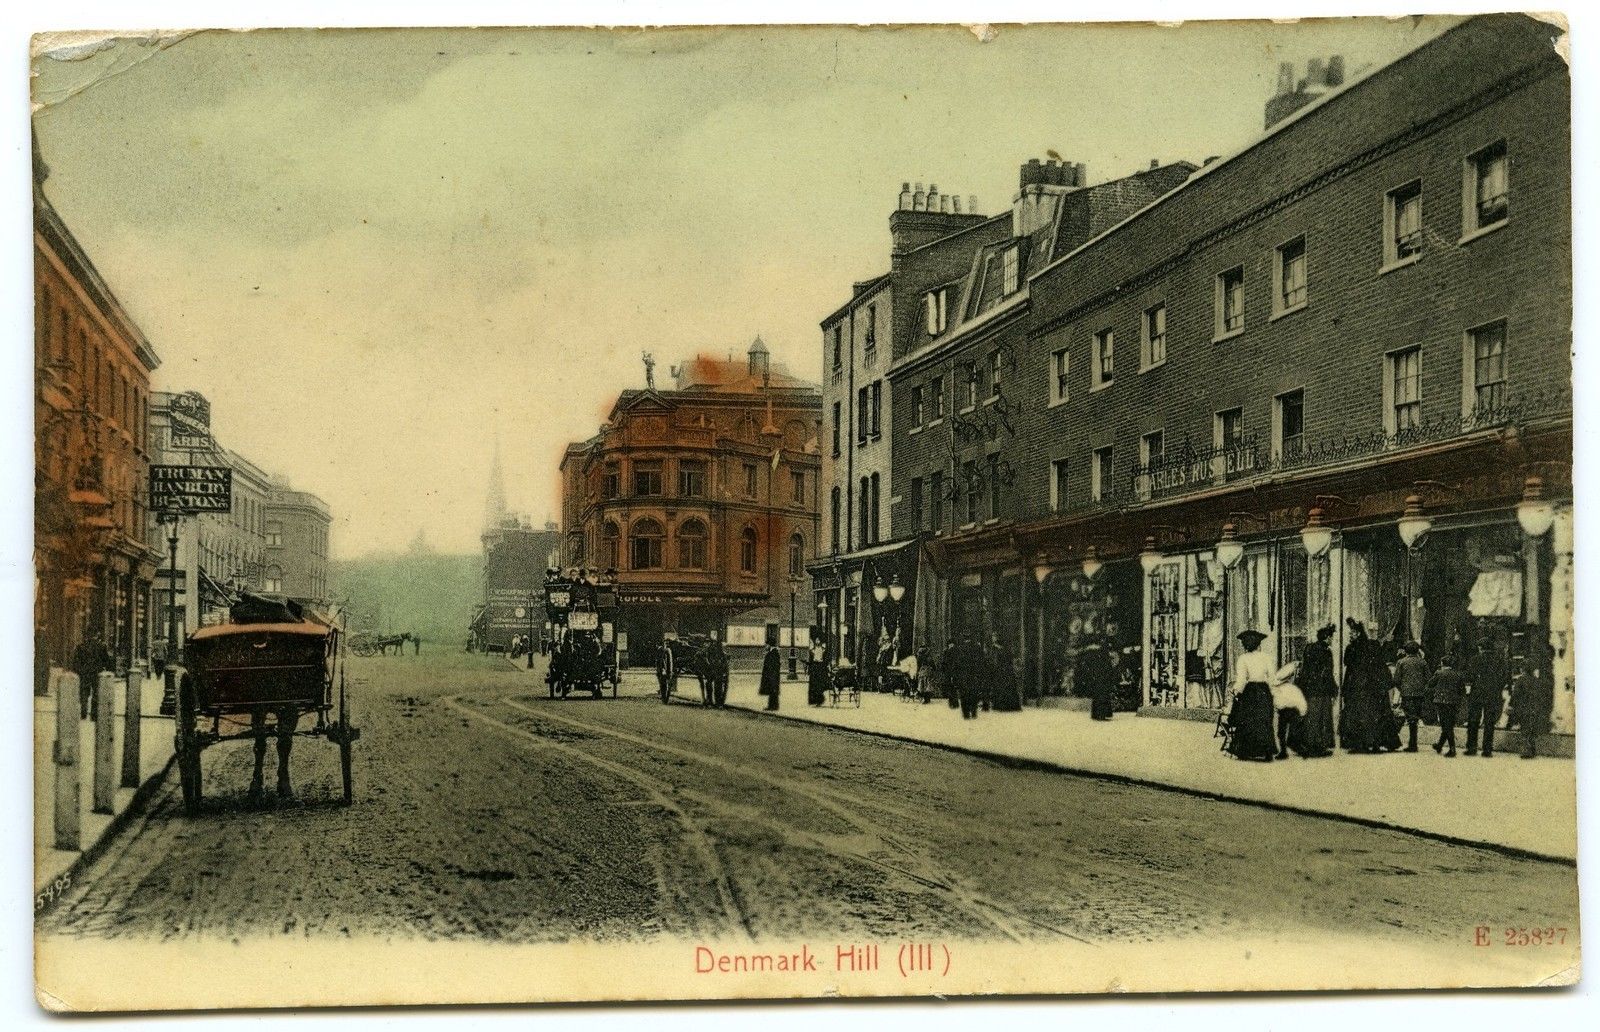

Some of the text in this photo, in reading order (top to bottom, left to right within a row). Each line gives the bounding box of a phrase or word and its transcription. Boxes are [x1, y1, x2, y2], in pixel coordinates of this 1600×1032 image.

[172, 436, 209, 447] ARMS
[1134, 449, 1255, 494] CARLES RUSELL
